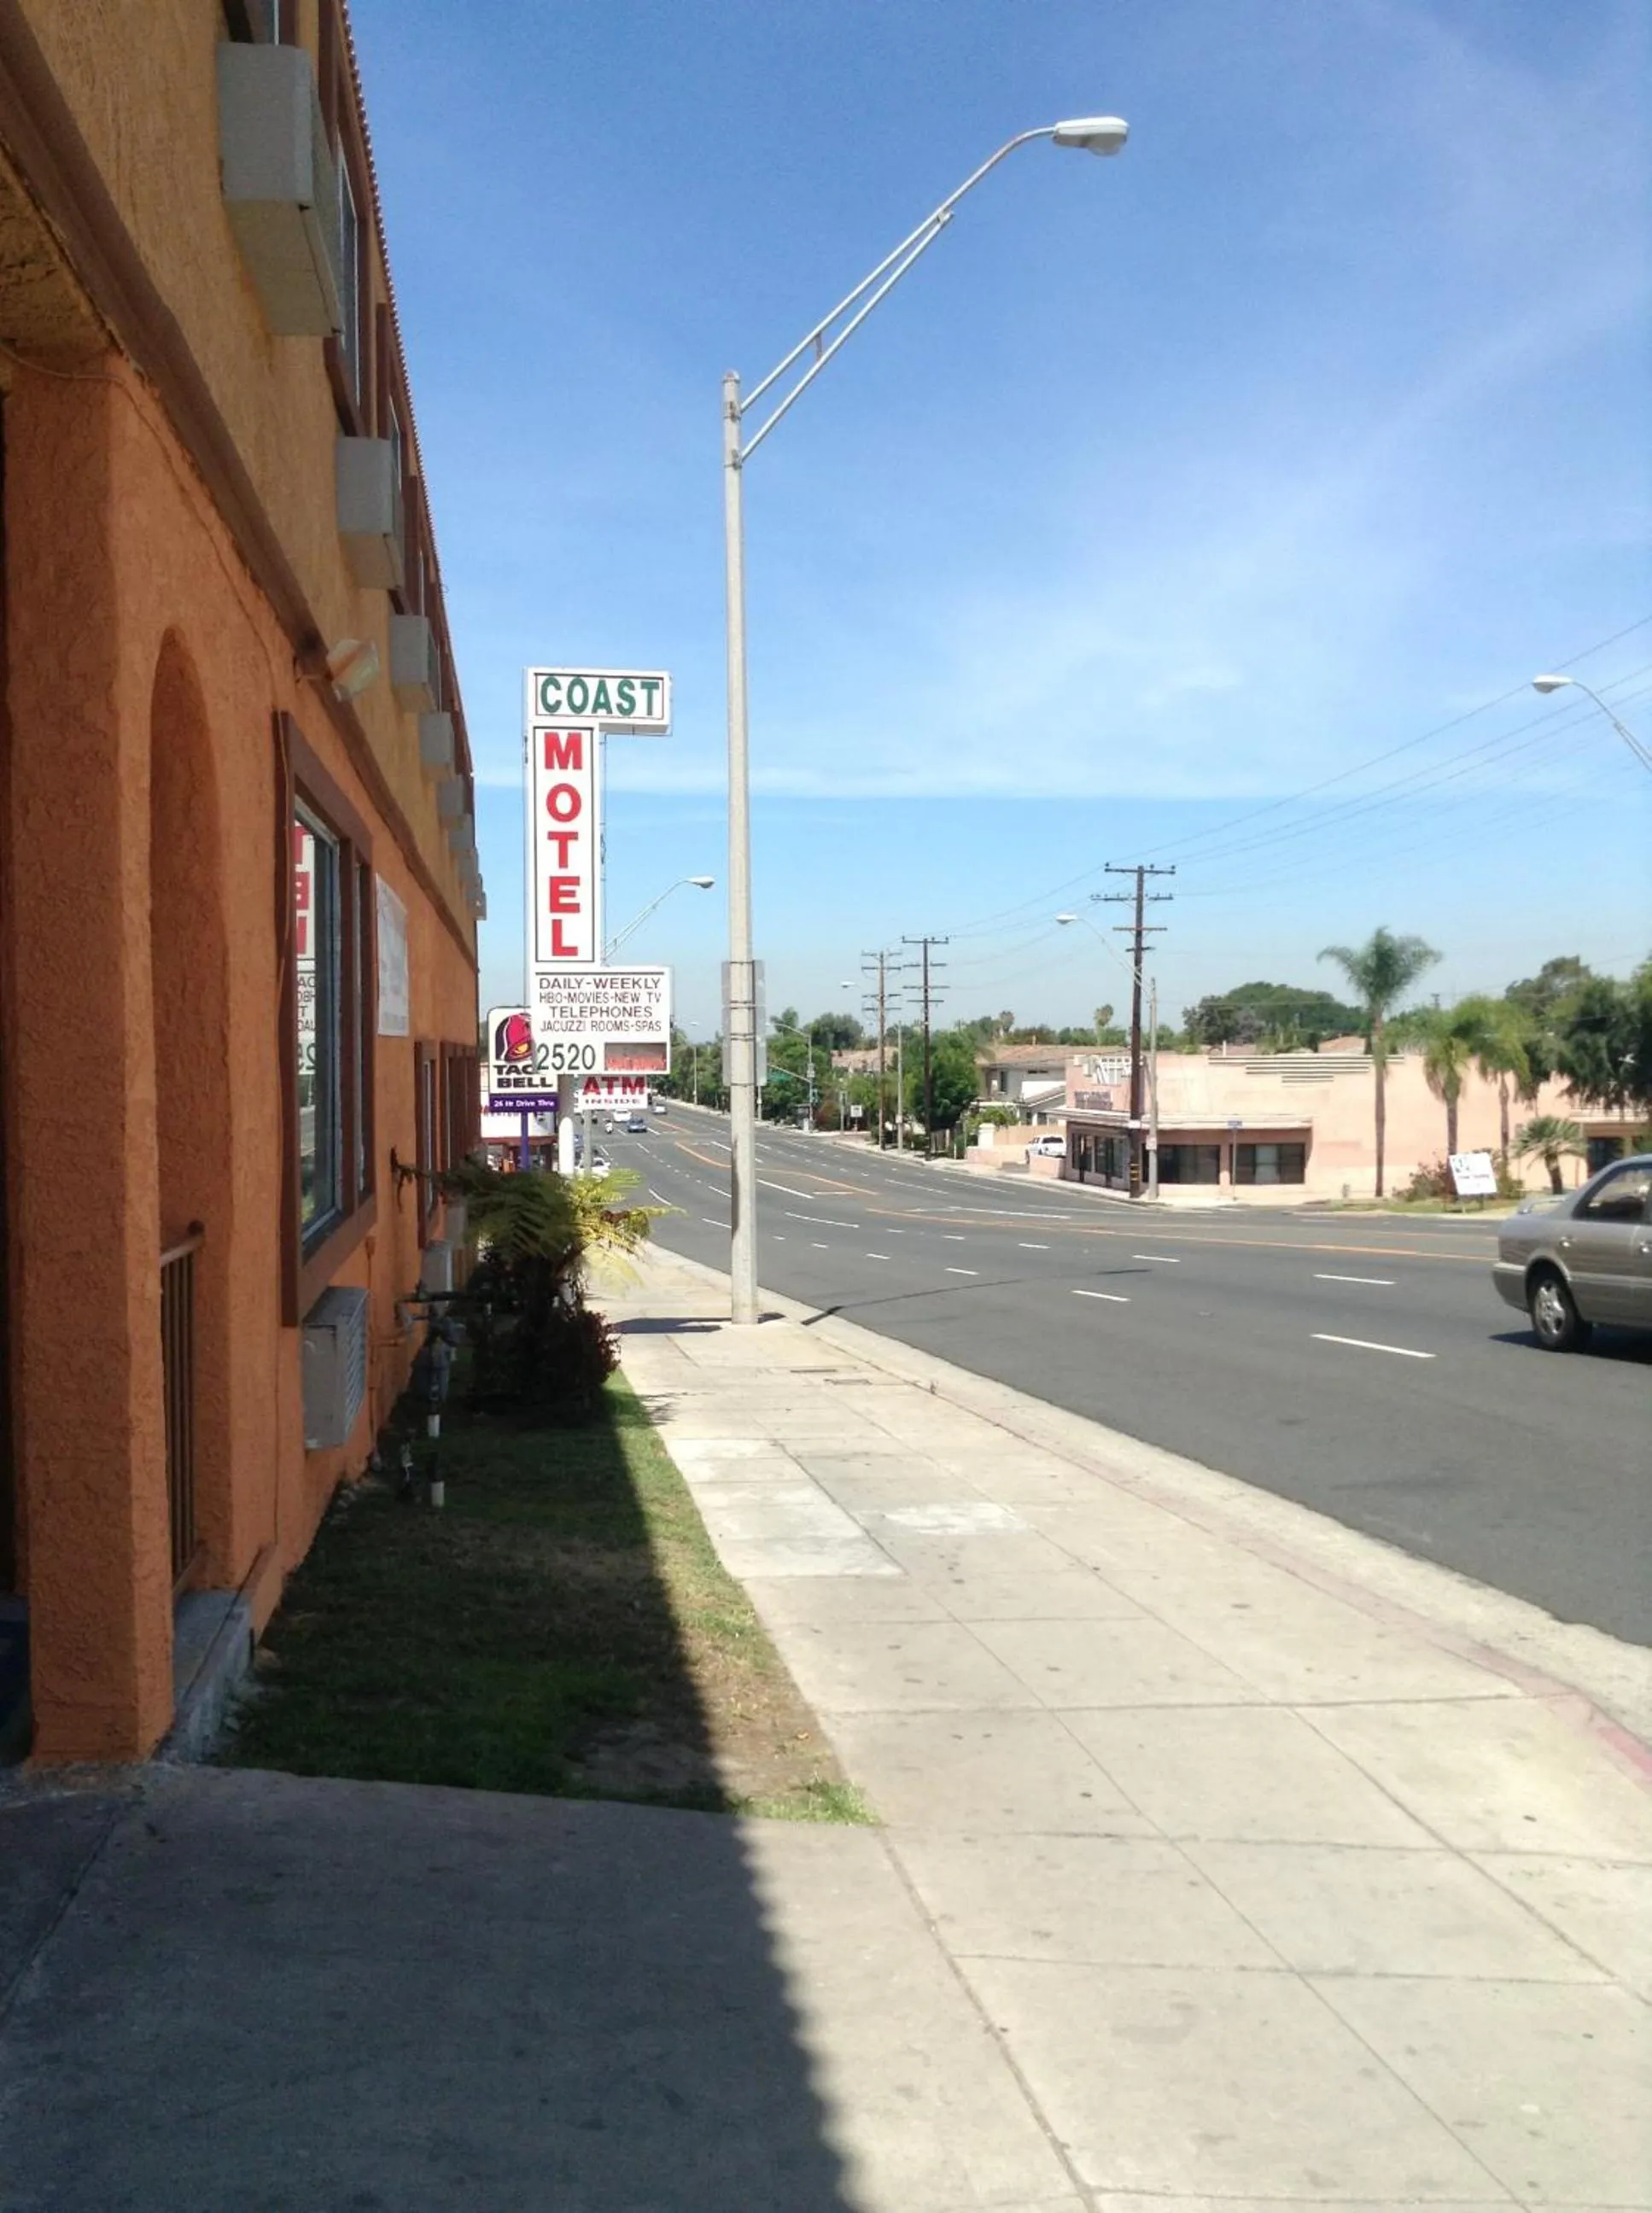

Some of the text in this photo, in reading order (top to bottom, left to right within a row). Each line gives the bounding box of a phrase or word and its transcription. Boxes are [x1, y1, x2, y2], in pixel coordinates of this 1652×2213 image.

[540, 675, 660, 717] COAST
[544, 732, 583, 957] MOTEL
[539, 977, 661, 990] DAILY-WEEKLY
[647, 991, 662, 1004] TV
[549, 1006, 653, 1019] TELEPHONES
[540, 1020, 587, 1032] JACUZZI
[536, 1042, 596, 1071] 2520
[493, 1064, 540, 1076] TAC
[496, 1077, 554, 1089] BELL
[582, 1076, 645, 1095] ATM
[537, 1099, 555, 1107] Thru
